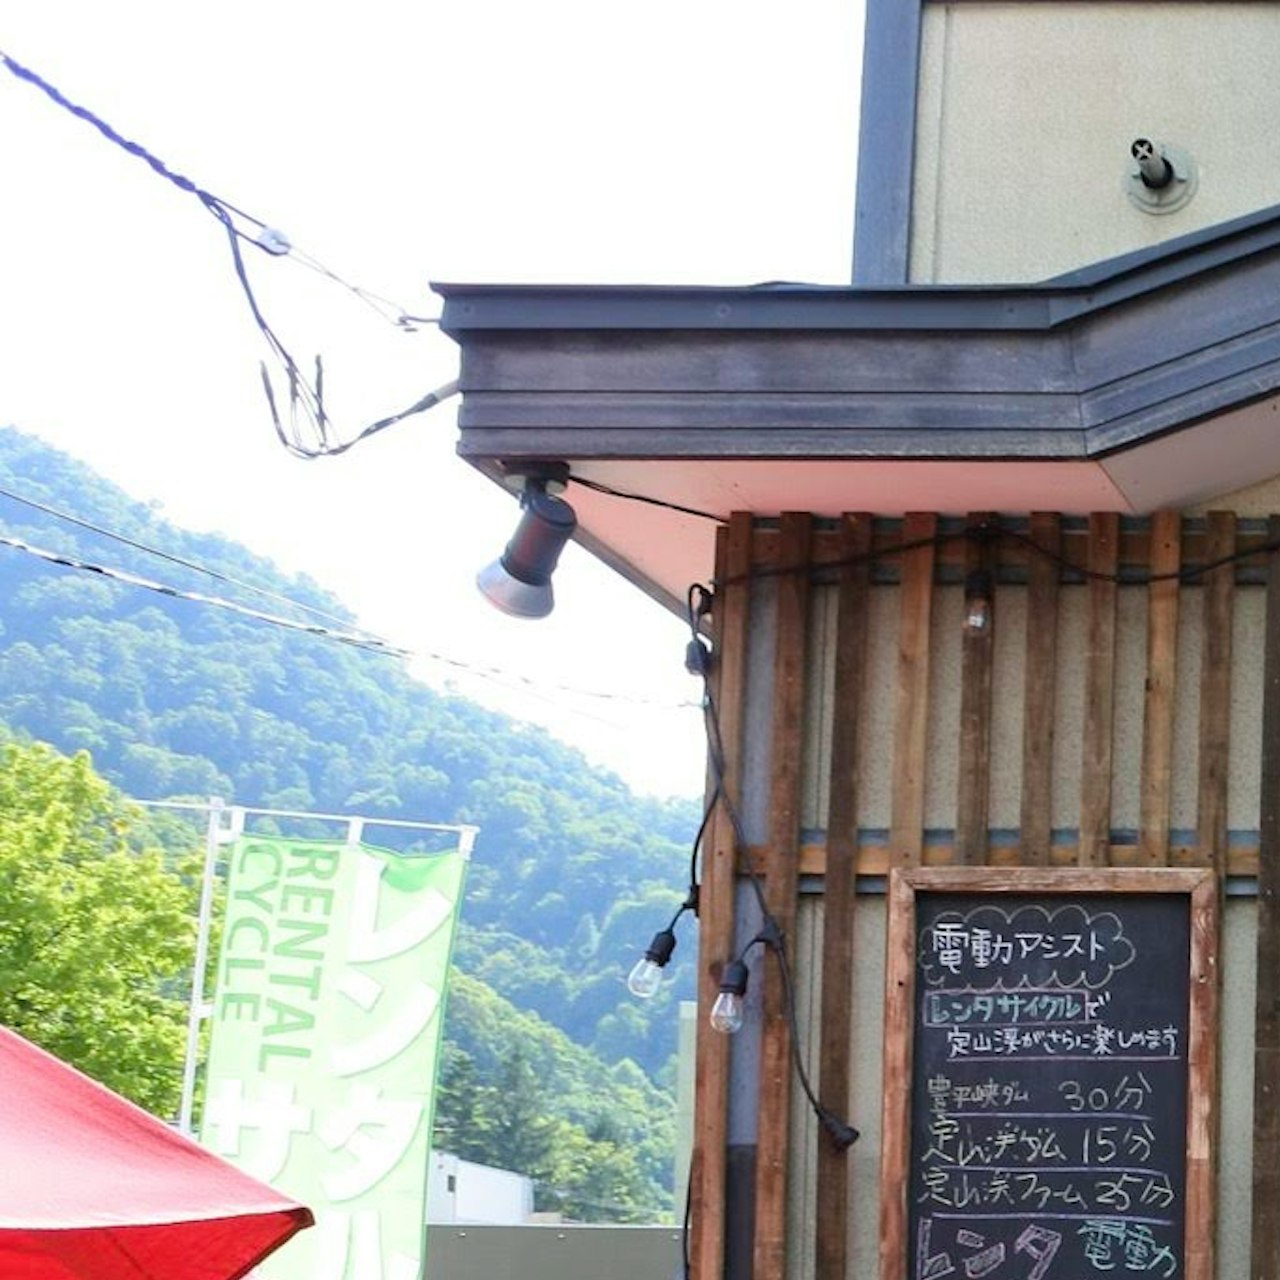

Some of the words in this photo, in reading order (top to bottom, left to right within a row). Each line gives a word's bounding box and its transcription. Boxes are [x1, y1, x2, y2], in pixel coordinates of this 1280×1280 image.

[221, 843, 284, 1022] CYCLE
[932, 923, 1105, 974] 電動アシスト
[257, 848, 340, 1073] RENTAL
[930, 991, 1112, 1023] レンタサイクルで
[947, 1024, 1178, 1057] 定山渓がさらに楽しめます
[1058, 1072, 1152, 1112] 30分
[1083, 1123, 1154, 1165] 15分
[1095, 1174, 1175, 1212] 25分
[1077, 1219, 1177, 1278] 電動
